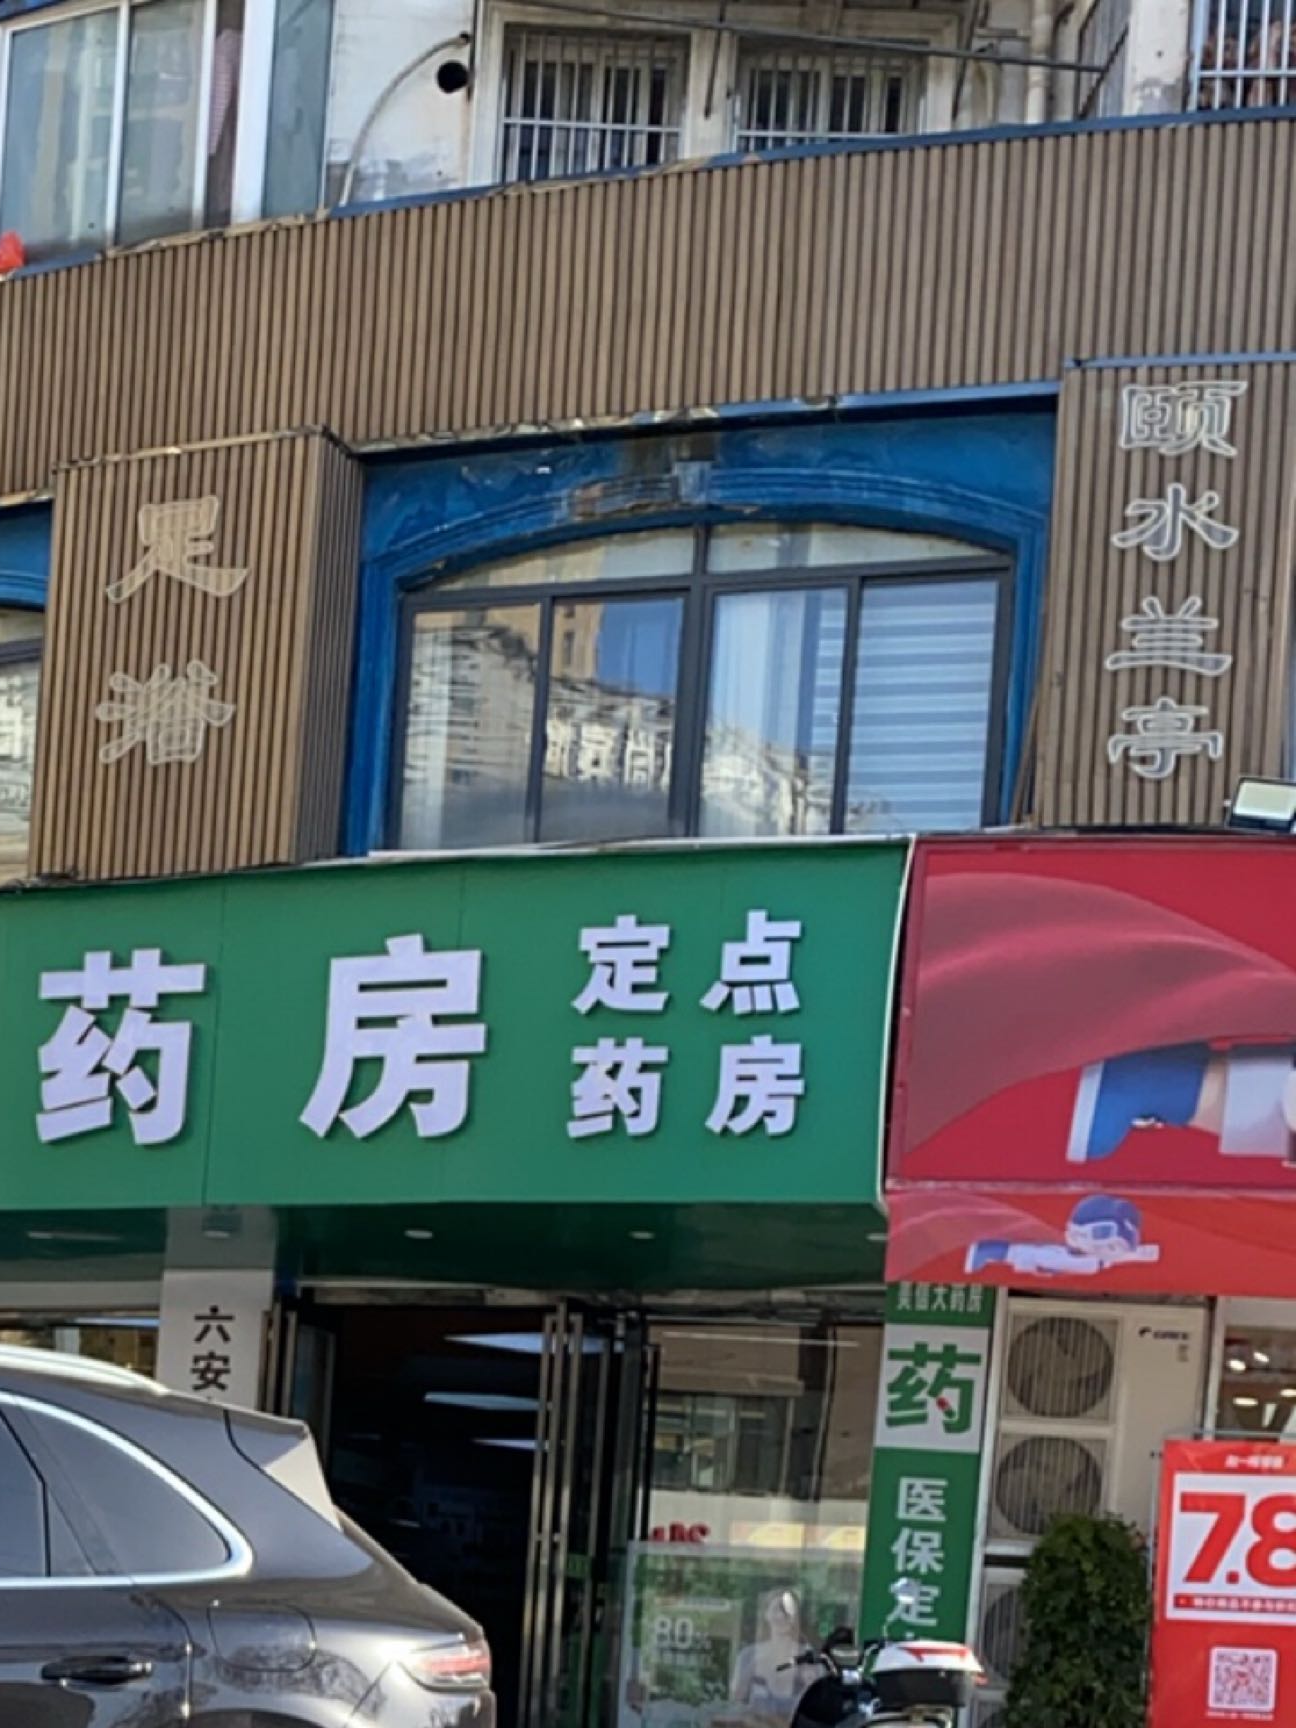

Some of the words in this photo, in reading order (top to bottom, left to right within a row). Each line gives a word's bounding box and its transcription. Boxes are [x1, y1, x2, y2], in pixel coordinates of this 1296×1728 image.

[1105, 381, 1247, 780] 颐水兰亭
[571, 909, 802, 1016] 定点
[566, 1033, 805, 1139] 药房
[191, 1305, 235, 1403] 六安
[886, 1341, 982, 1434] 药
[887, 1476, 948, 1641] 医保定
[1180, 1491, 1296, 1588] 7.8
